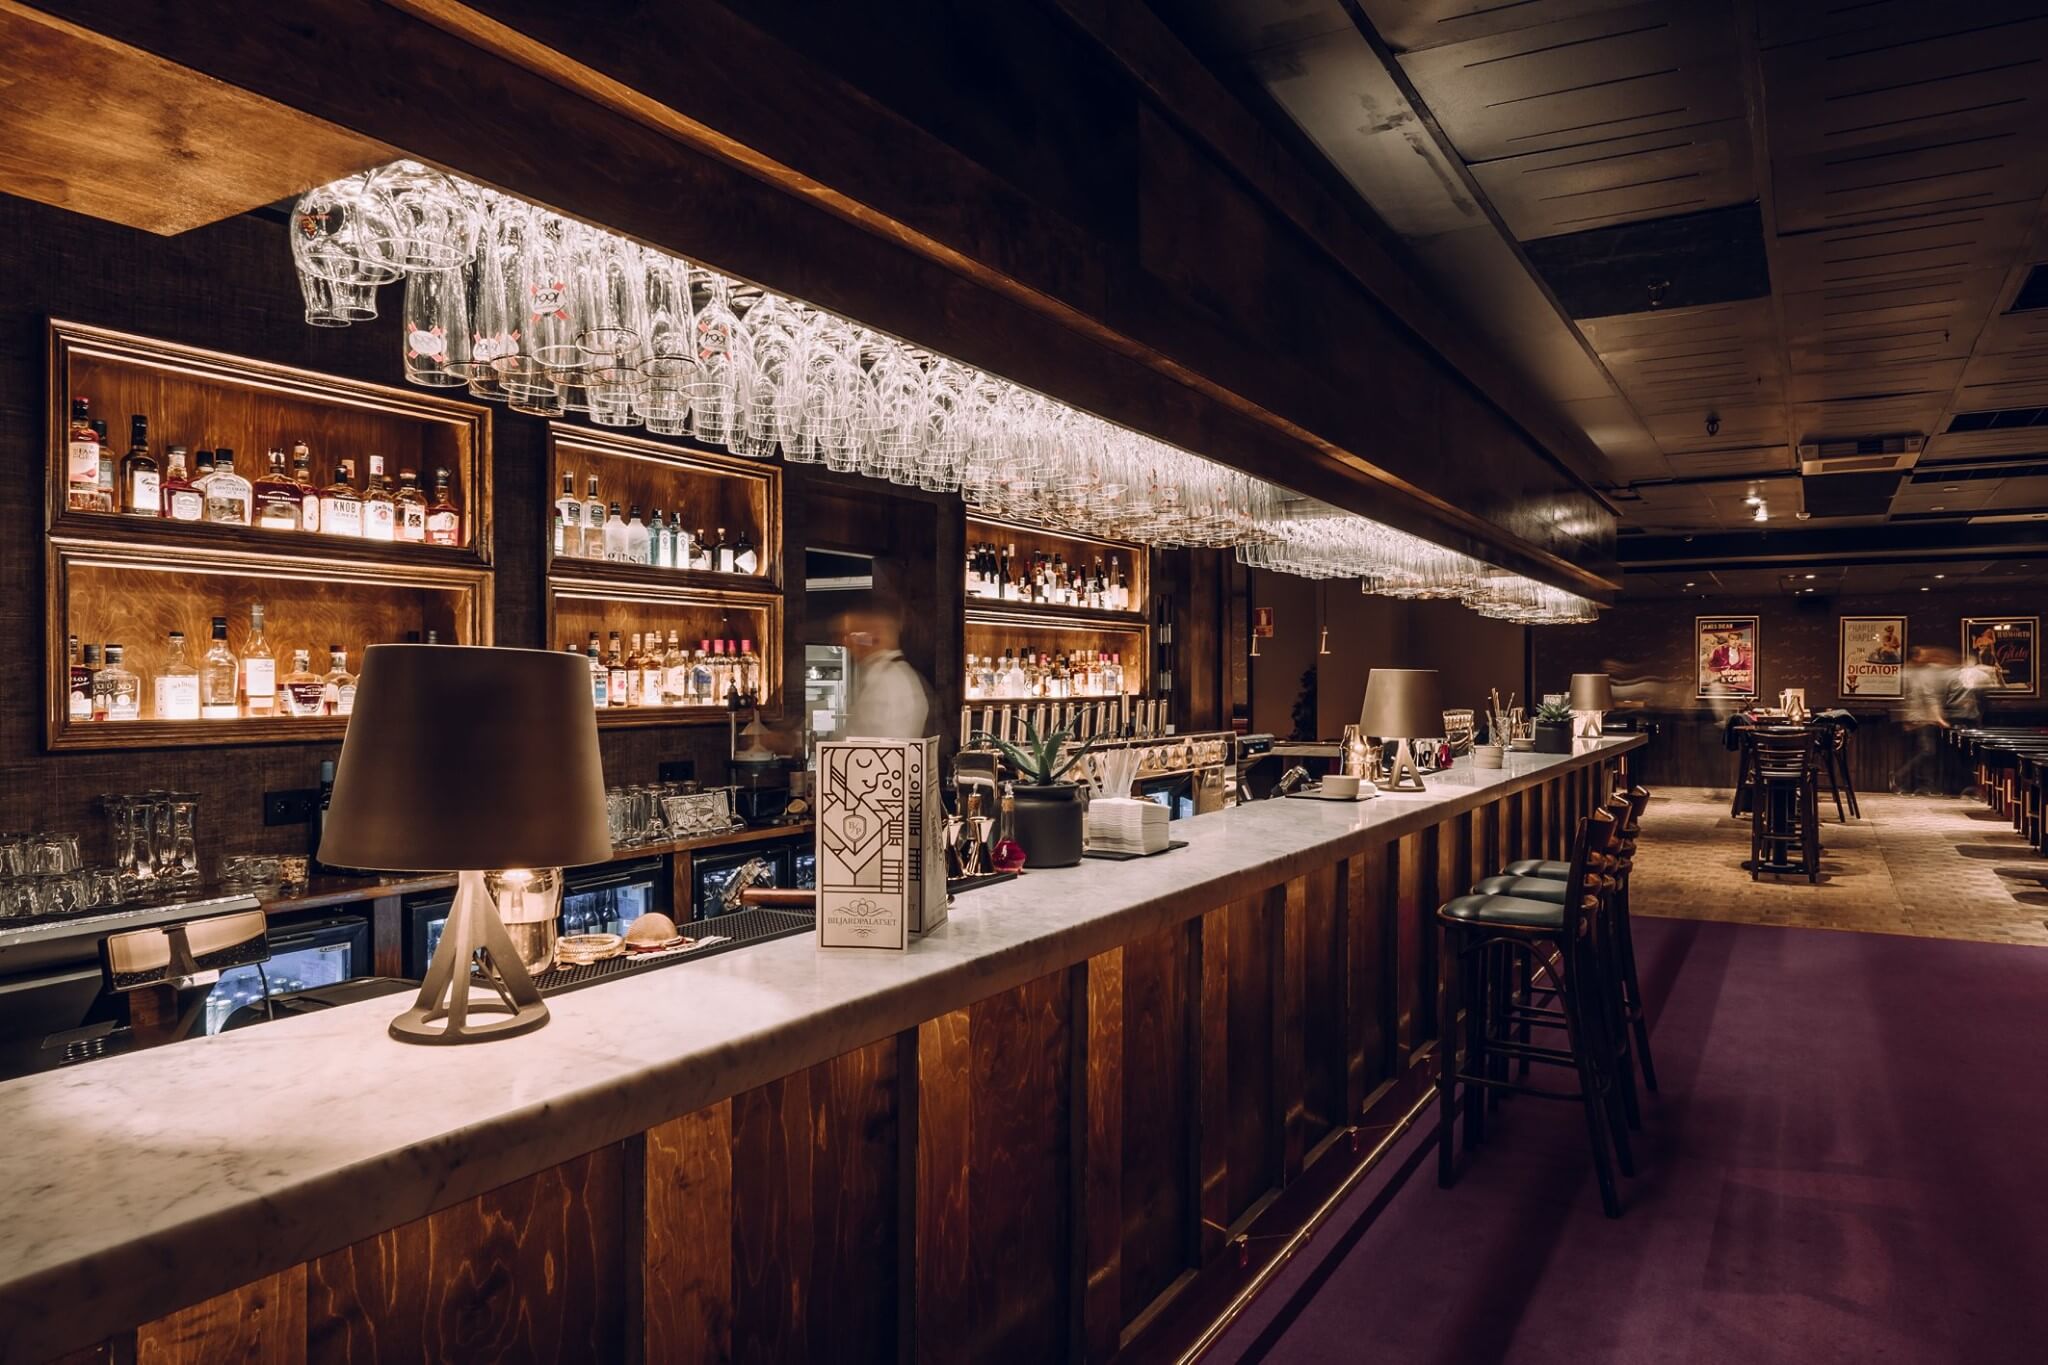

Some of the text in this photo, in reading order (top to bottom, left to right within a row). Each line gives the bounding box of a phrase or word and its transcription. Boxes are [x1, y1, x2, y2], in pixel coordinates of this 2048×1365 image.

[333, 501, 356, 513] KNOB
[1848, 665, 1898, 675] DICTATOR
[828, 916, 896, 927] BILJARDPALATSET
